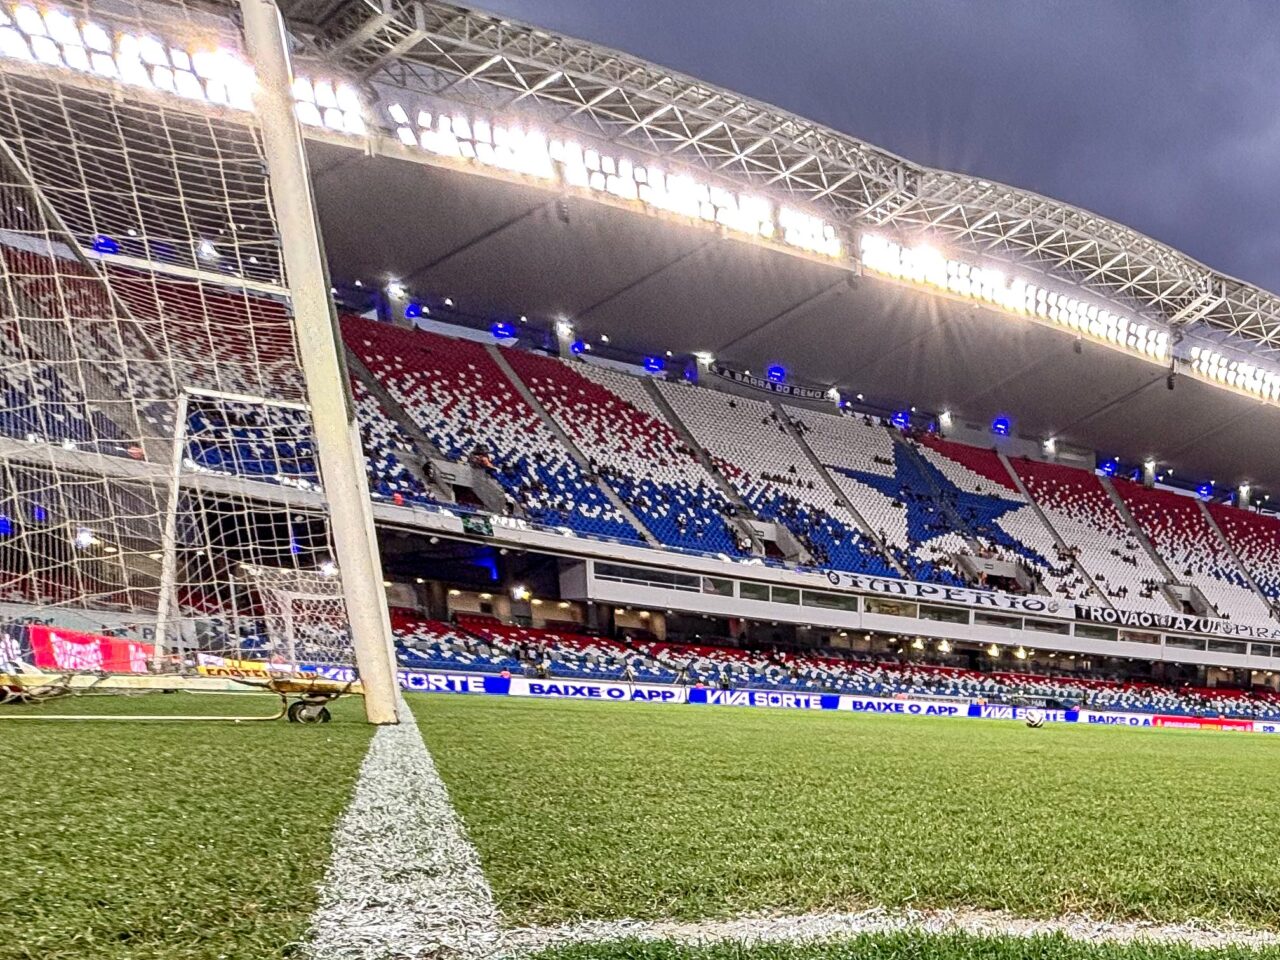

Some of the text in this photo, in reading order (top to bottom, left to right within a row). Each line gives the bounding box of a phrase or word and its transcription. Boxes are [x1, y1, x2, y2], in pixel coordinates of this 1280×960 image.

[734, 373, 771, 390] BARRA
[792, 387, 822, 397] REMO
[529, 683, 675, 701] BAIXE O APP
[706, 689, 823, 709] VIVA SORTE
[852, 700, 958, 716] BAIXE O APP
[980, 706, 1013, 719] VIVA
[1088, 715, 1127, 725] BAIXE
